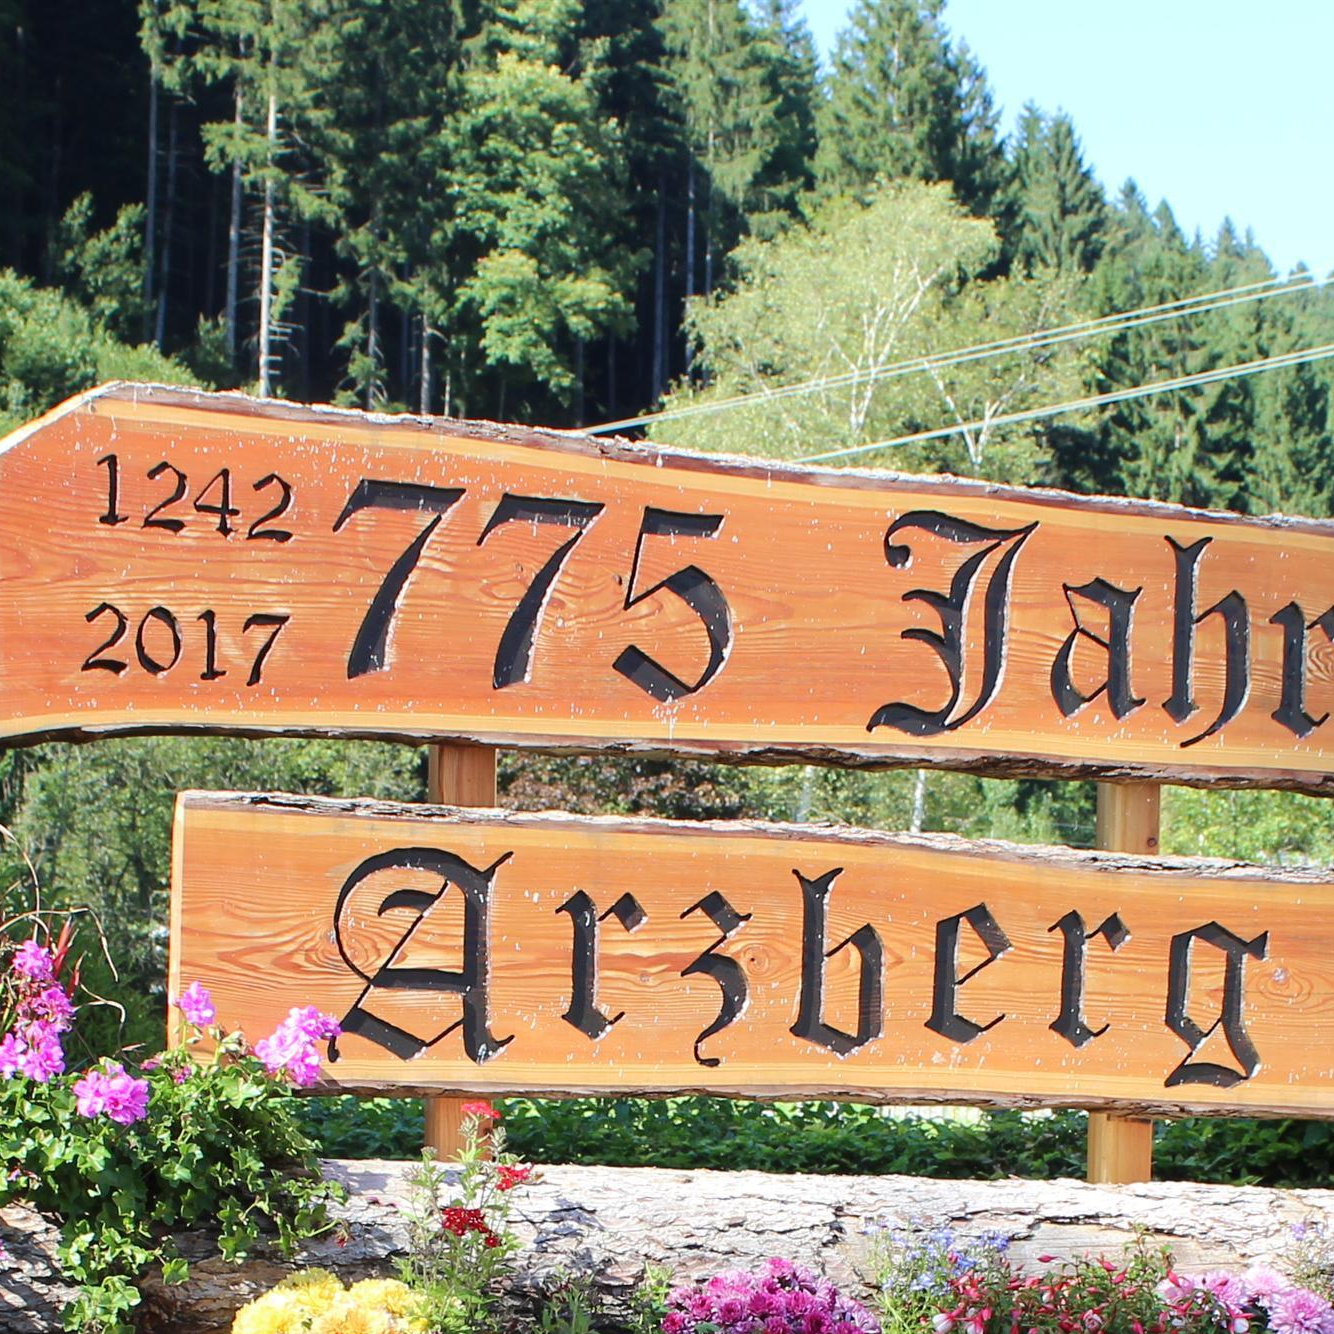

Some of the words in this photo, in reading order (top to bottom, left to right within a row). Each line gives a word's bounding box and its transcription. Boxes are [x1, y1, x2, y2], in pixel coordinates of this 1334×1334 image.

[96, 453, 294, 543] 1242
[81, 602, 291, 687] 2017
[332, 479, 732, 703] 775
[329, 846, 1269, 1088] Arzberg
